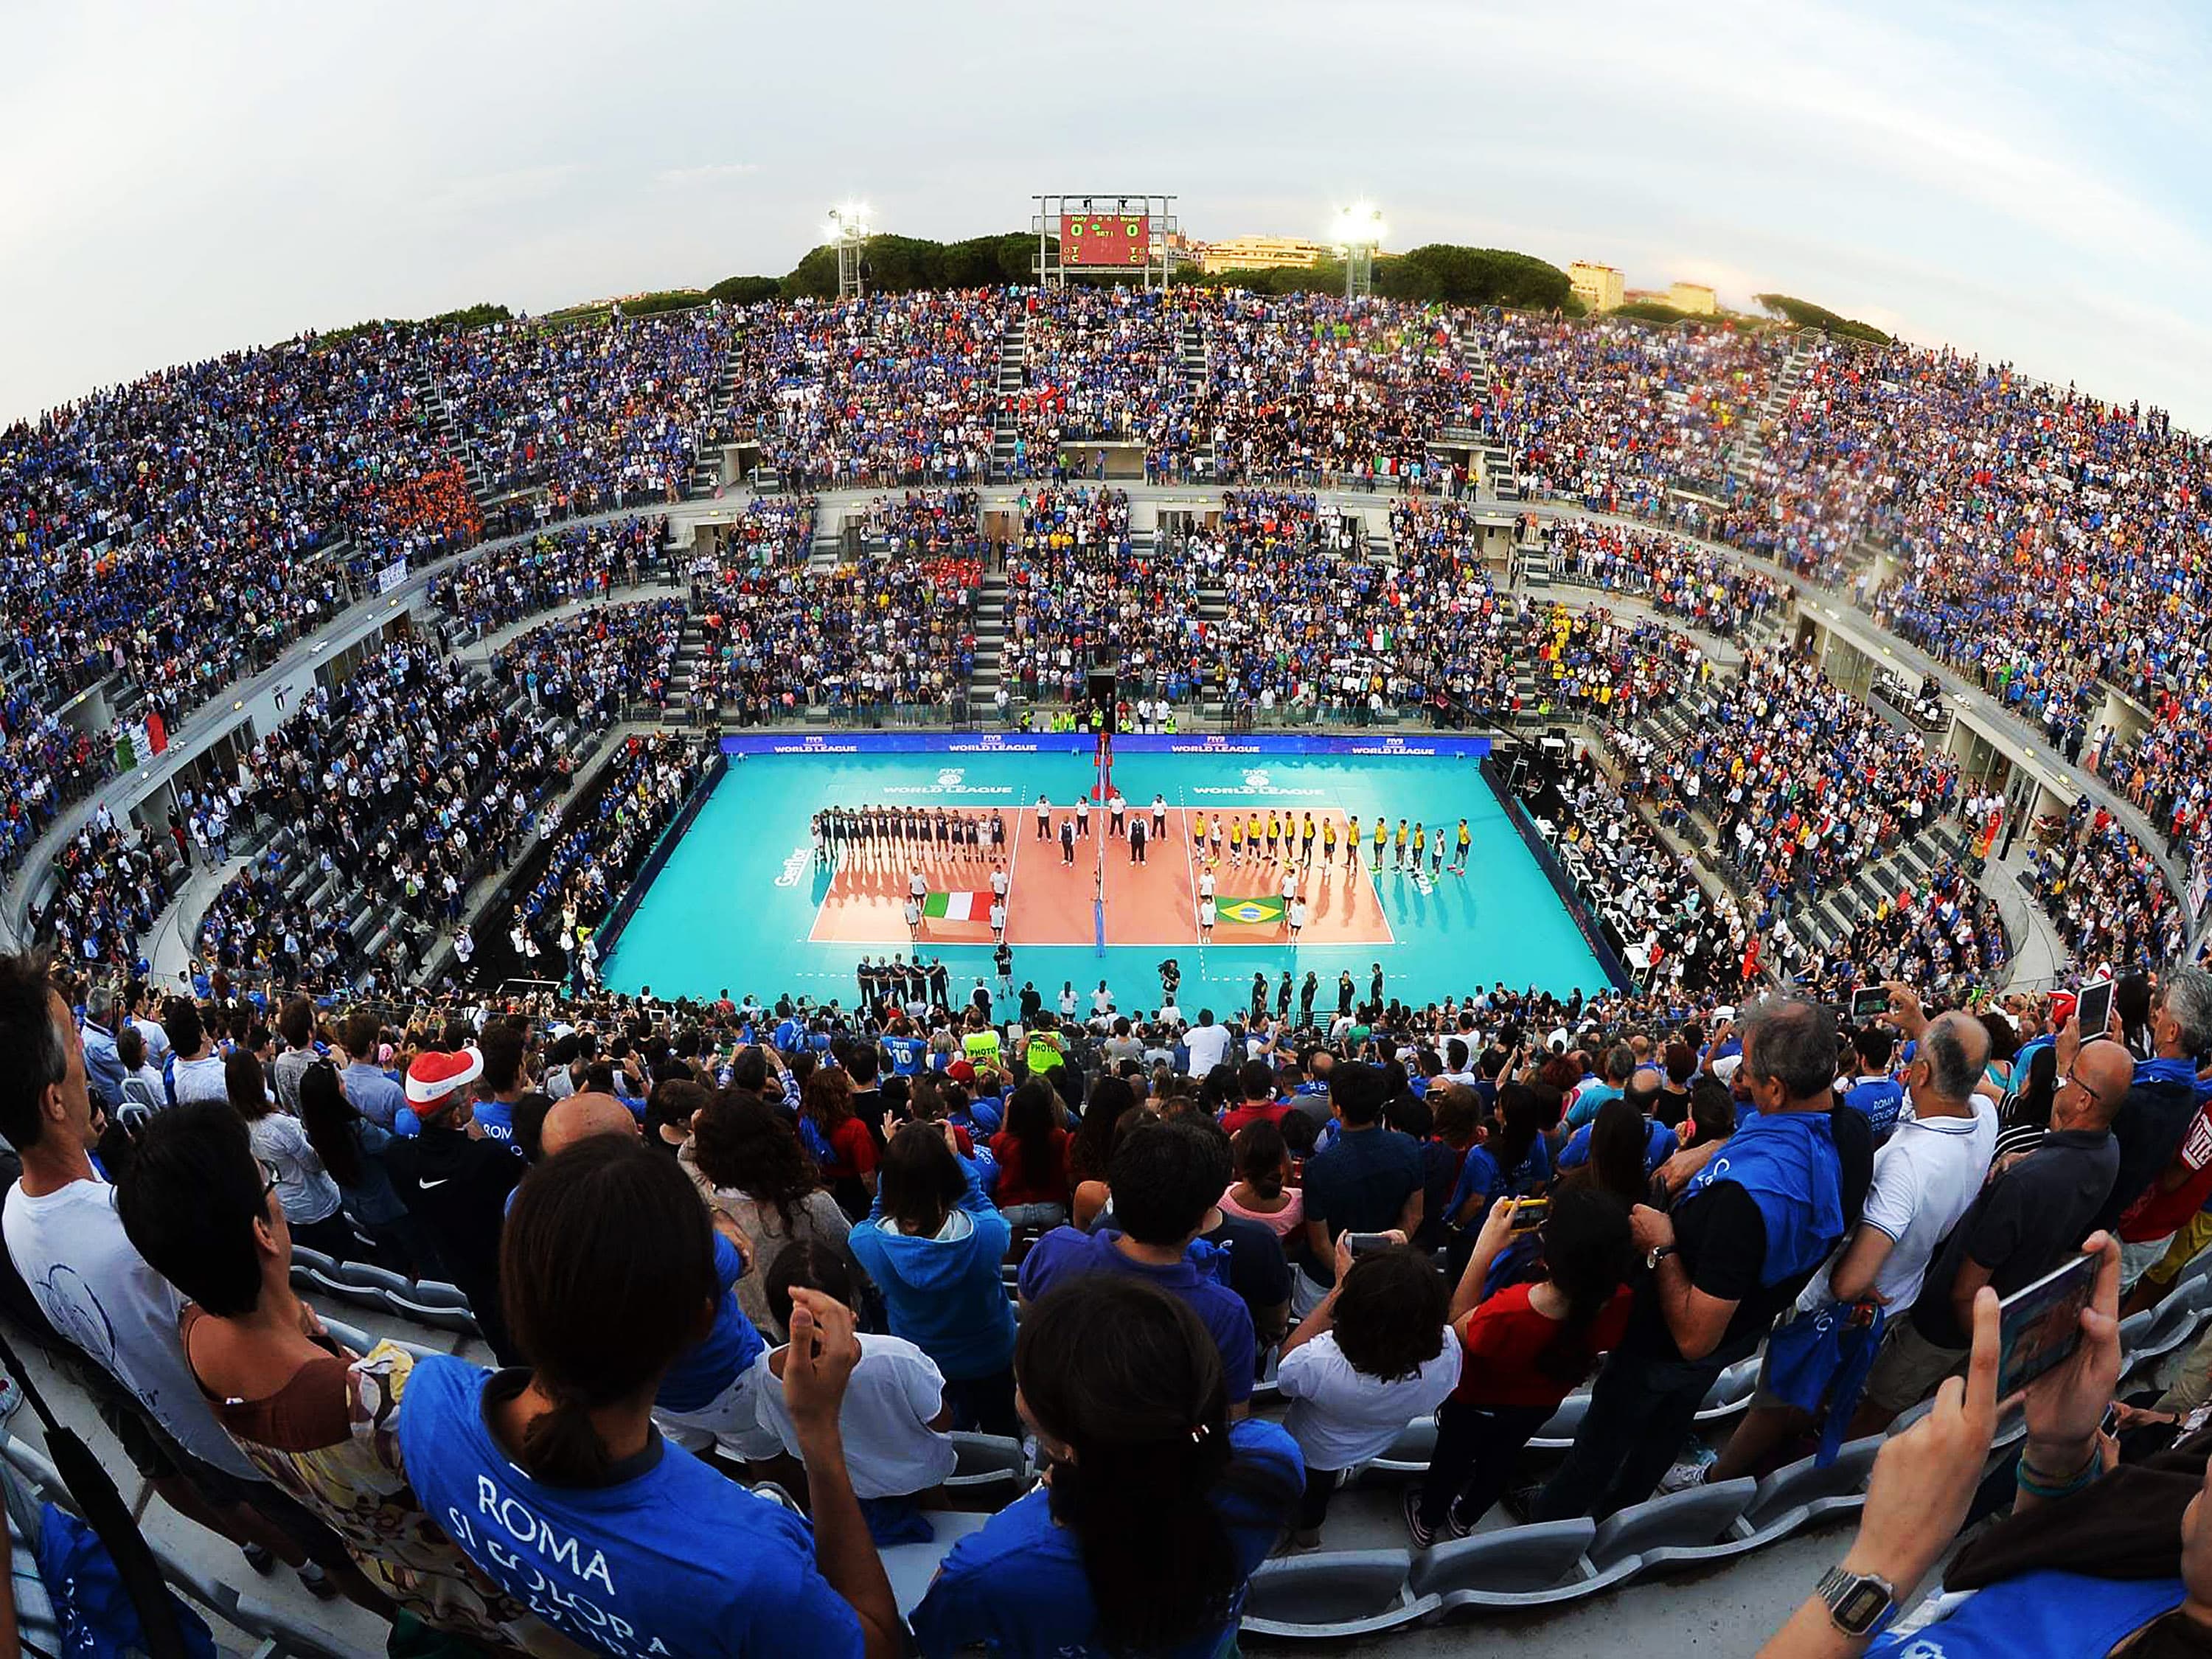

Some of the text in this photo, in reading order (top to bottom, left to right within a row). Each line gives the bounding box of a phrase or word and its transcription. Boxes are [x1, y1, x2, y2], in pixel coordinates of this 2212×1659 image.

[1071, 223, 1138, 237] 0 0
[1072, 246, 1079, 254] T
[1130, 255, 1138, 263] C
[1193, 787, 1325, 796] WORLD LEAGUE
[970, 1046, 996, 1057] PHOTO
[1030, 1043, 1057, 1053] PHOTO
[892, 1048, 913, 1064] 10
[478, 1474, 616, 1596] ROMA
